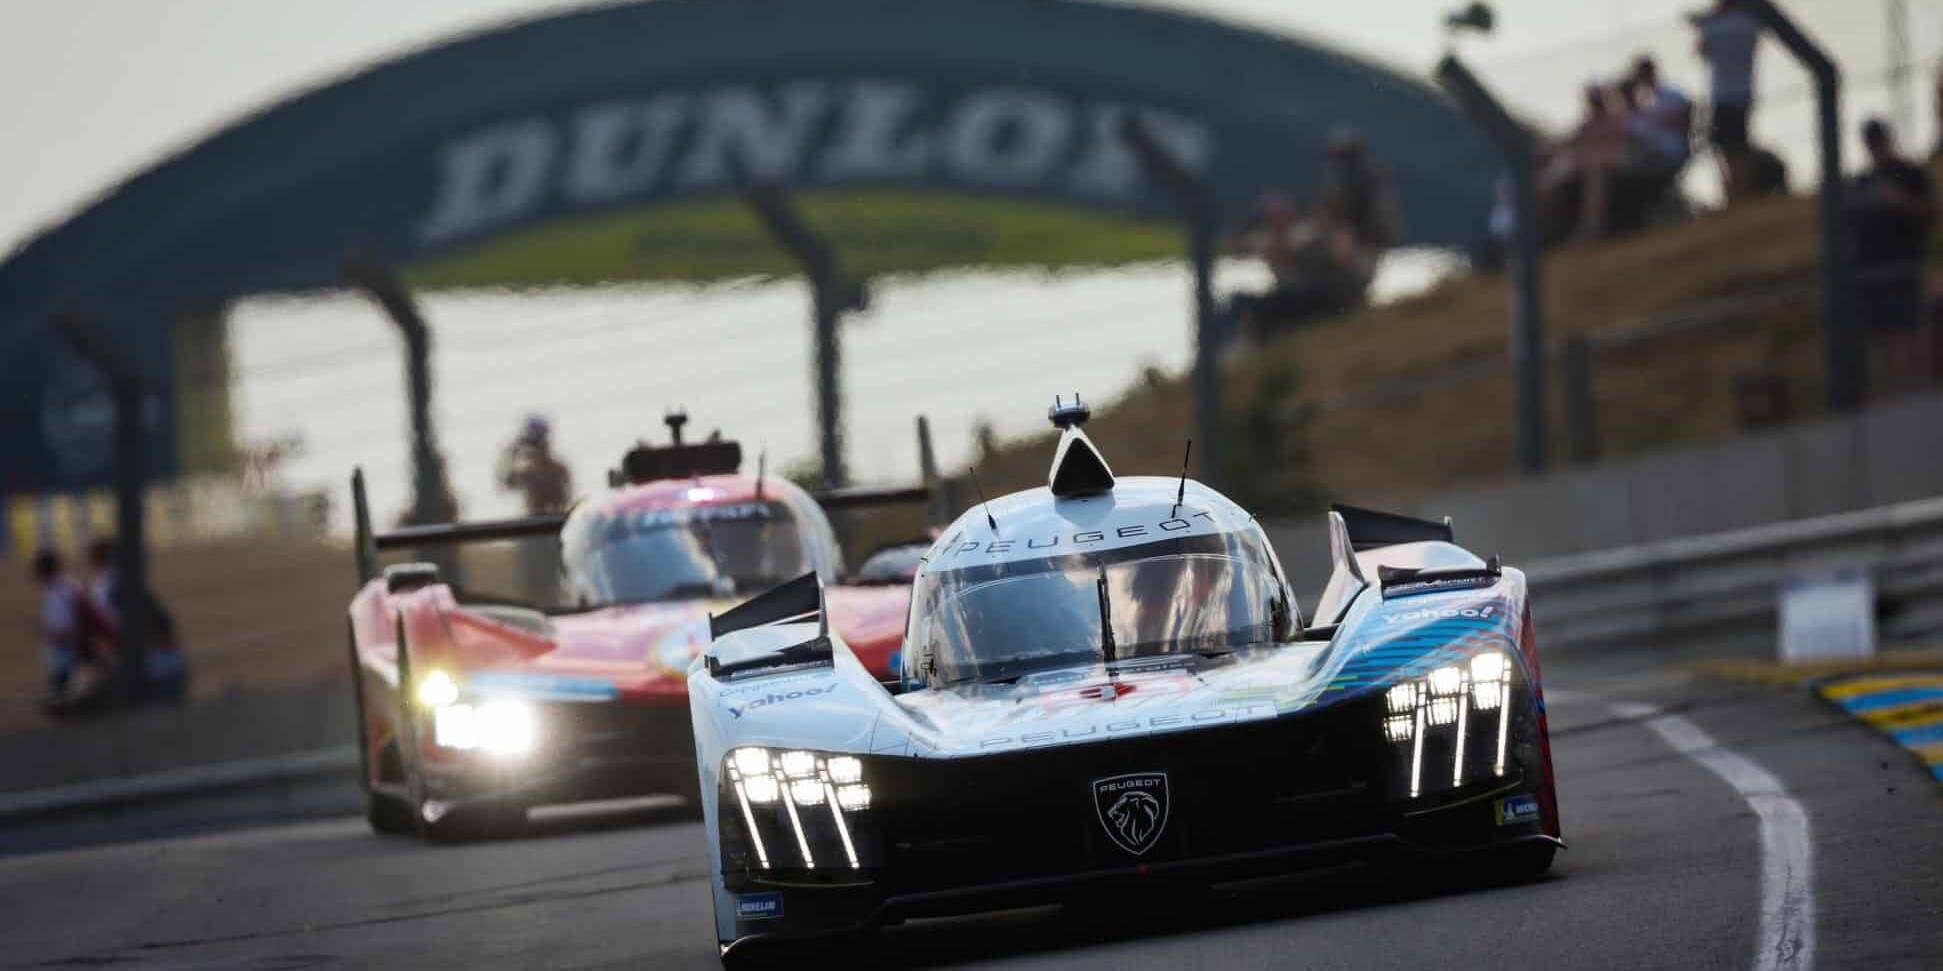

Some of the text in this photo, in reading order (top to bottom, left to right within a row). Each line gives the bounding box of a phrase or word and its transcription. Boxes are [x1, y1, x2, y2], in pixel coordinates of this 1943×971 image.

[954, 510, 1214, 556] PEUGEOT
[1382, 605, 1495, 624] yahoo!
[727, 682, 839, 719] yahoo!
[980, 704, 1266, 748] PEUGEOT
[1100, 778, 1161, 792] PEUGEOT
